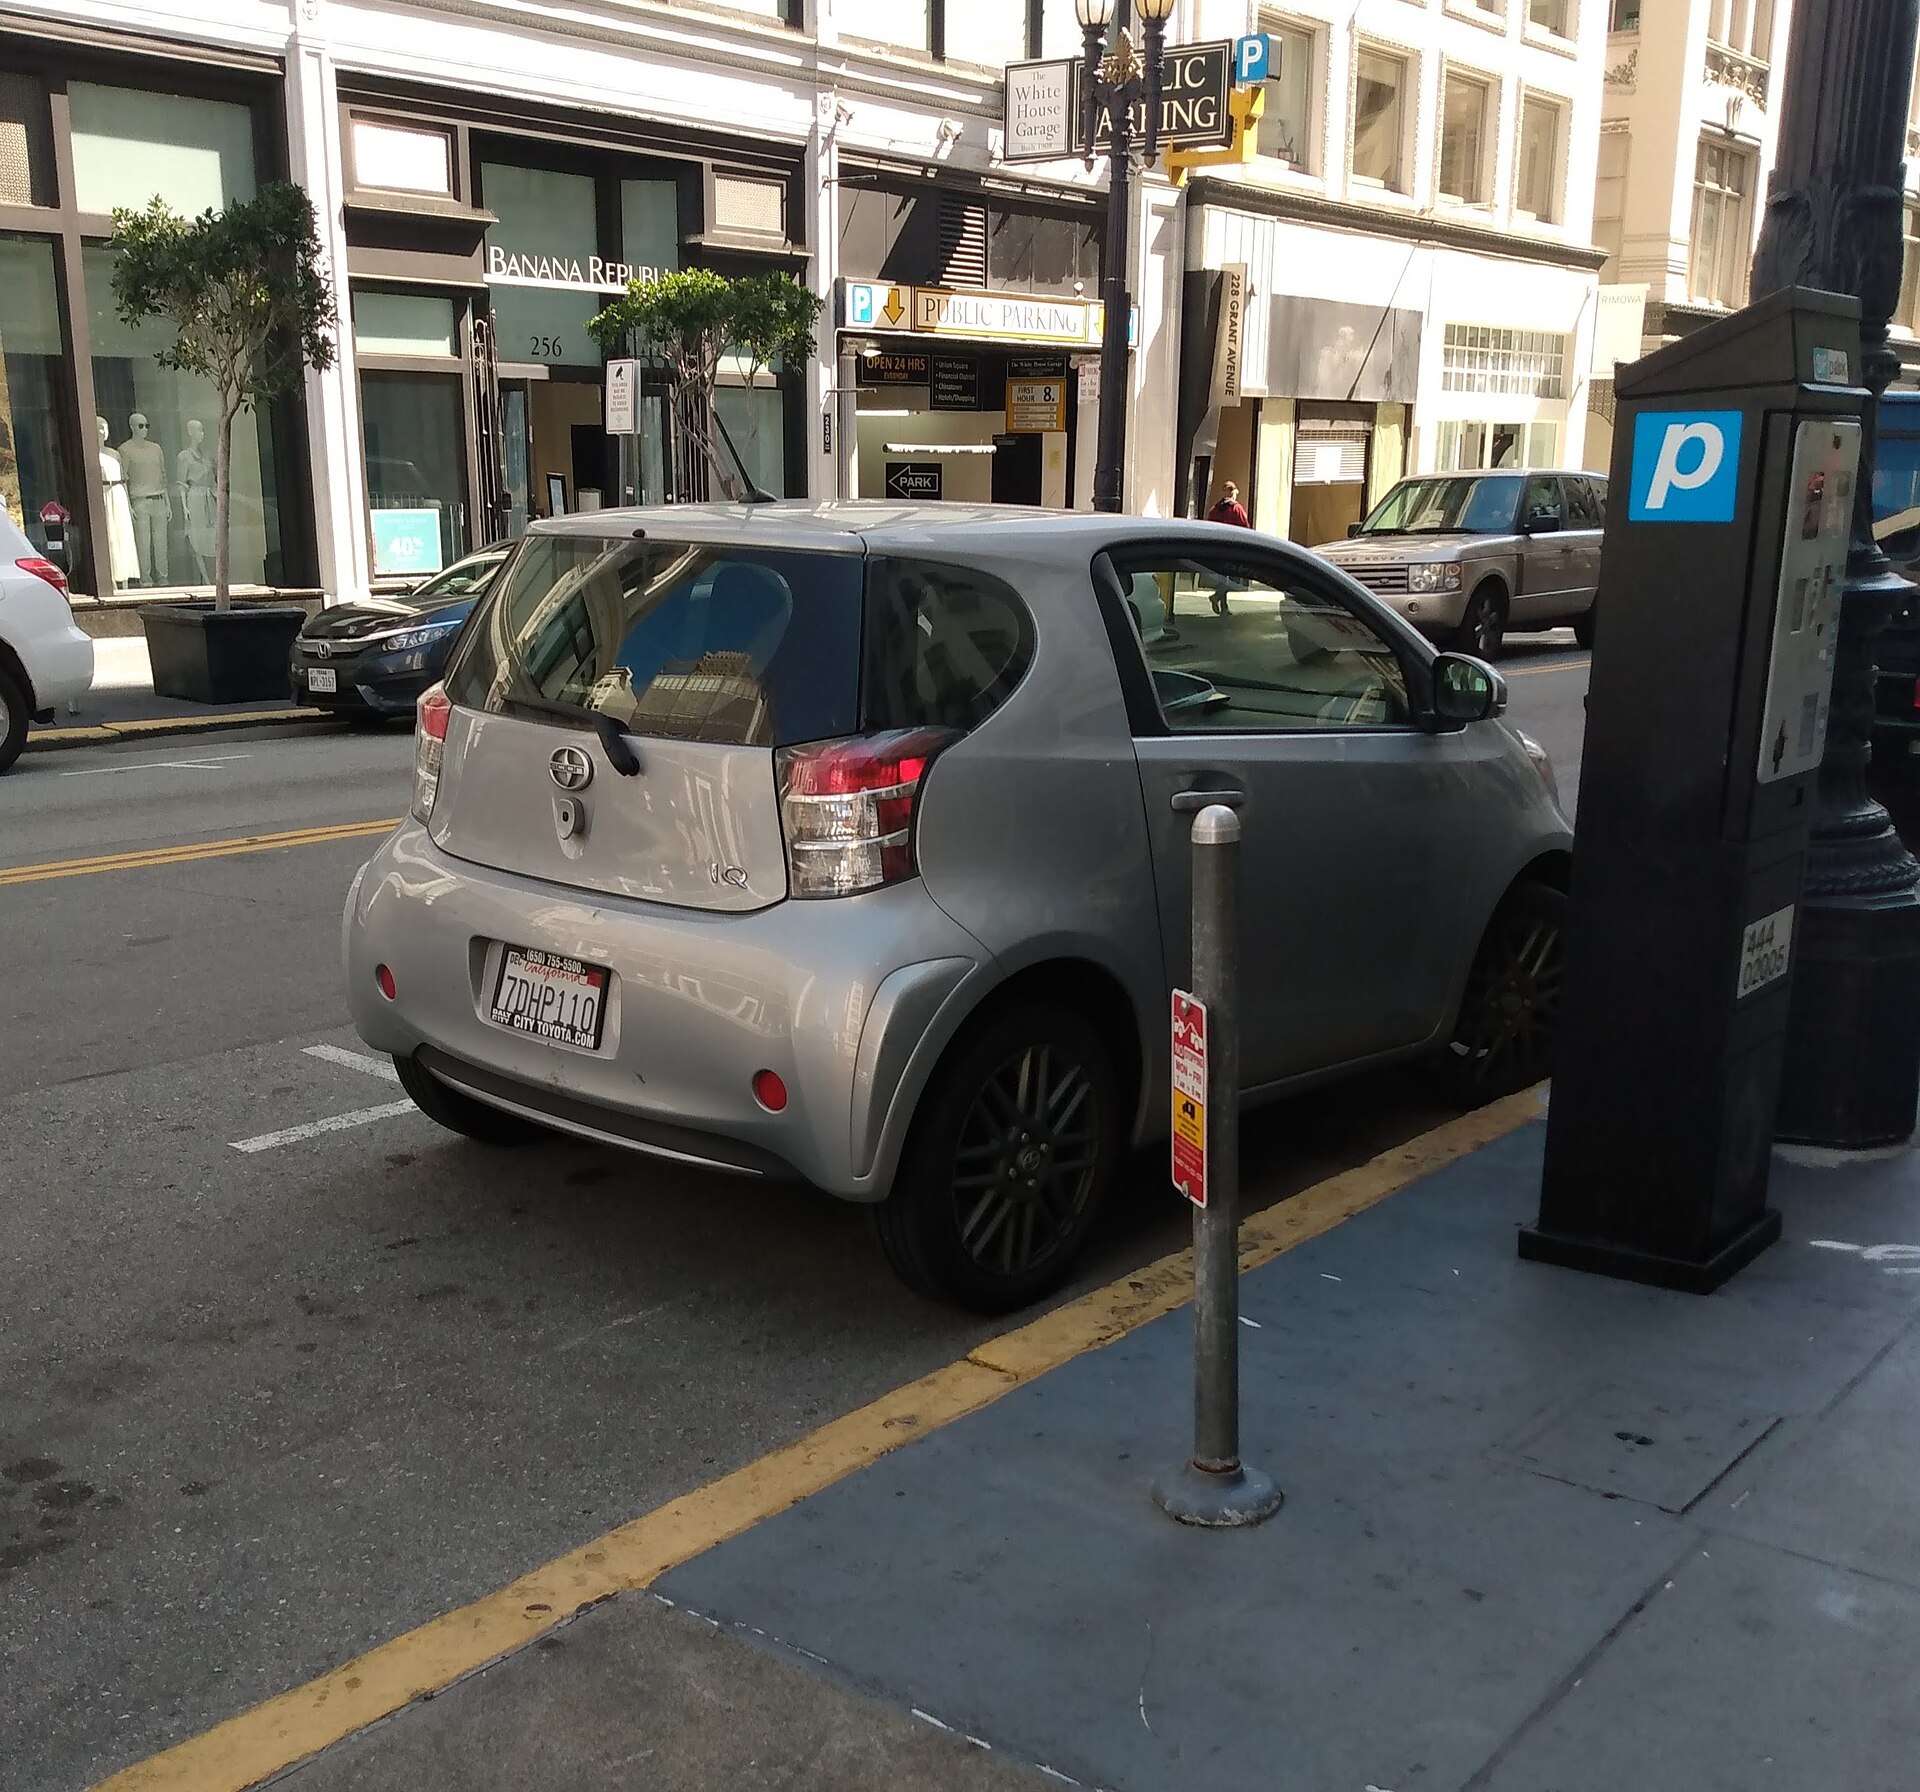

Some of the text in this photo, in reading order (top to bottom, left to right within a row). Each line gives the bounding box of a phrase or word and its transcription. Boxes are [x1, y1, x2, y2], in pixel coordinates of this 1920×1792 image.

[1242, 39, 1263, 77] P
[1032, 71, 1046, 81] The
[1015, 84, 1061, 101] White
[1016, 104, 1061, 119] House
[1015, 122, 1061, 141] Garage
[489, 246, 583, 283] BANANA
[1601, 295, 1641, 304] RIMOWA
[924, 297, 1078, 334] PUBLIC PARKING
[1225, 274, 1240, 397] 228 GRANT AVENUE
[530, 336, 562, 357] 256
[866, 356, 926, 371] OPEN 24 HRS
[938, 361, 969, 371] Union Square
[938, 372, 976, 381] Financial District
[938, 383, 963, 391] Chinatown
[1018, 386, 1034, 395] FIRST
[1016, 395, 1035, 403] HOUR
[900, 476, 932, 488] PARK
[526, 948, 582, 975] (650) 755-5500
[503, 975, 595, 1032] 7DHP110
[513, 1014, 595, 1049] CITY TOYOTA.COM
[1175, 1059, 1188, 1077] MON
